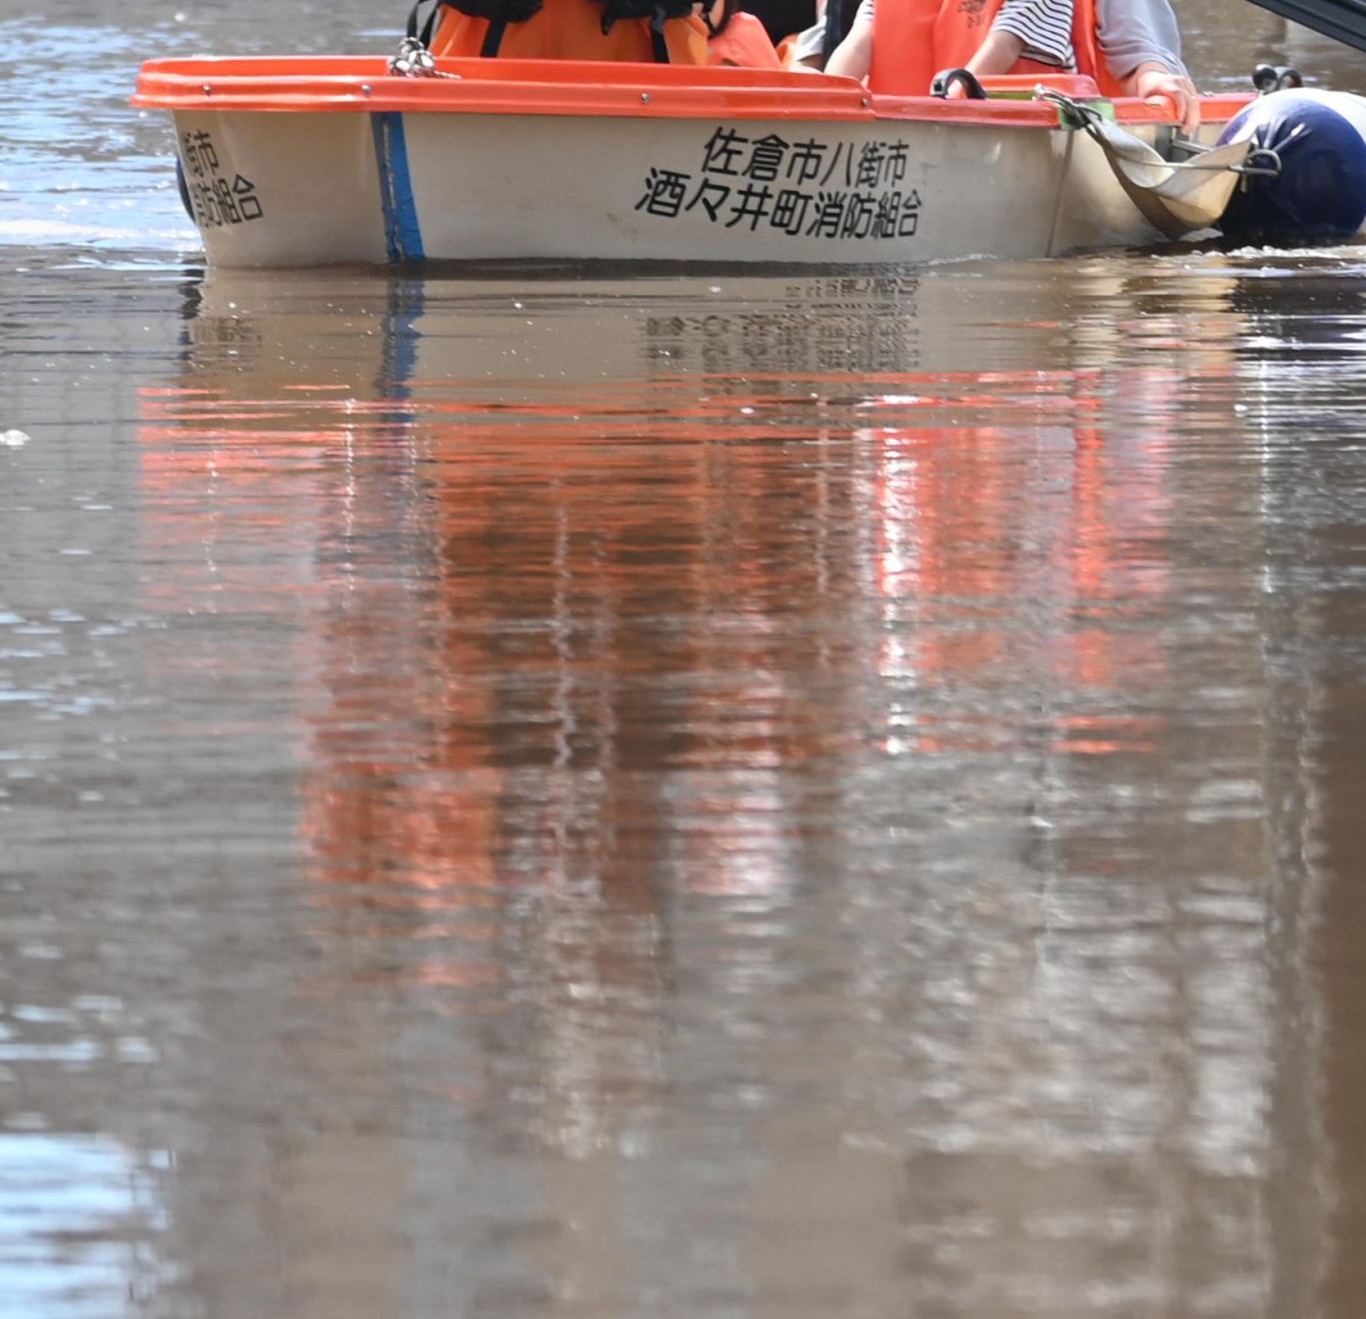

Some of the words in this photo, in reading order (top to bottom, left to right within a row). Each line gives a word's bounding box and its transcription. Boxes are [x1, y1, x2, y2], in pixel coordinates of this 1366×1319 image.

[701, 126, 910, 188] 佐倉市八街市
[635, 167, 922, 239] 酒々井町消防組合
